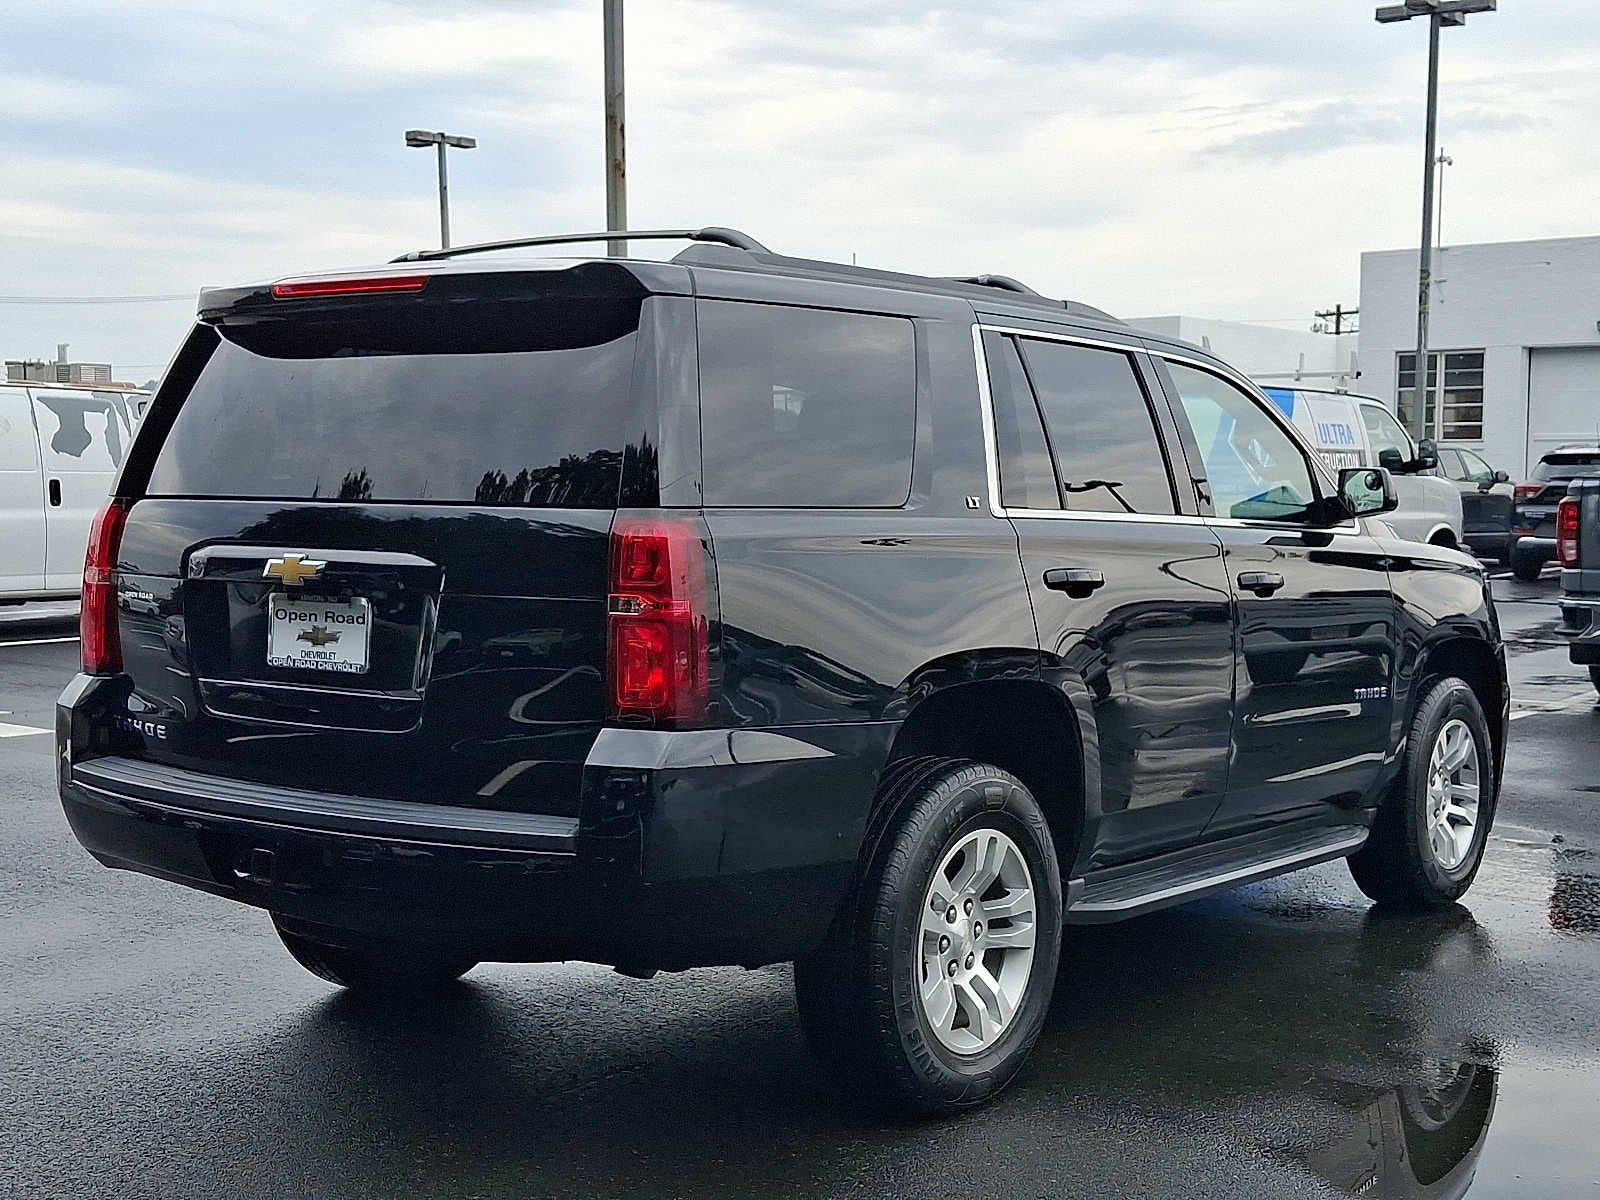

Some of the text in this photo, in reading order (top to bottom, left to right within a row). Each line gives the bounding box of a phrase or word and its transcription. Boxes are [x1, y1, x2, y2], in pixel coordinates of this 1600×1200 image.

[1317, 423, 1355, 445] ULTRA
[966, 495, 981, 509] LT
[275, 608, 366, 624] Open Road
[300, 650, 336, 660] CHEVROLET
[272, 656, 361, 673] OPEN ROAD CHEVROLET
[1354, 687, 1388, 700] TAHOE
